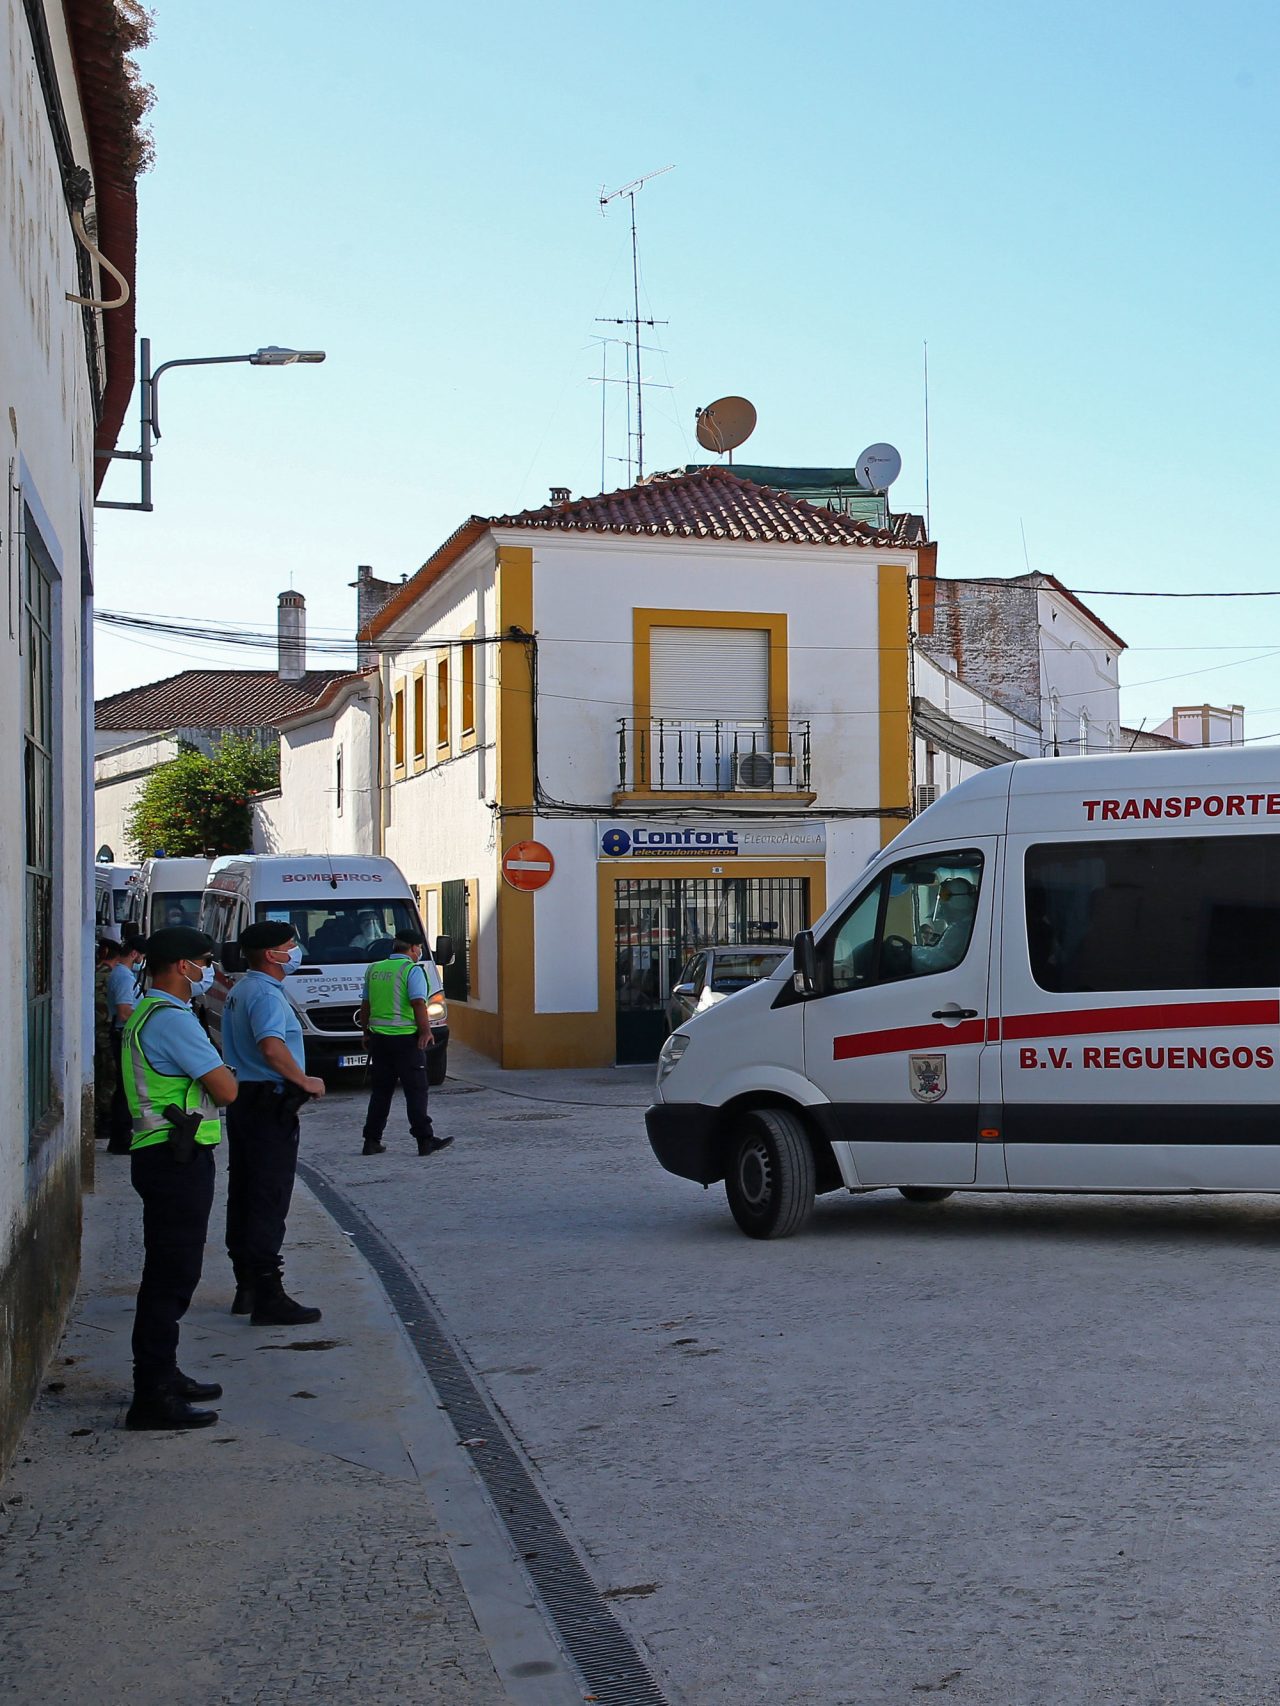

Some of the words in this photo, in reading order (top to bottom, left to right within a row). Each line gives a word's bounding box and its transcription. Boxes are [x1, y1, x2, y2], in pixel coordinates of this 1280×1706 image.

[633, 828, 738, 845] Confort
[634, 848, 737, 856] electrodomésticos
[281, 873, 383, 882] BOMBEIROS
[1020, 1047, 1073, 1069] B.V.
[1083, 1046, 1274, 1069] REGUENGOS
